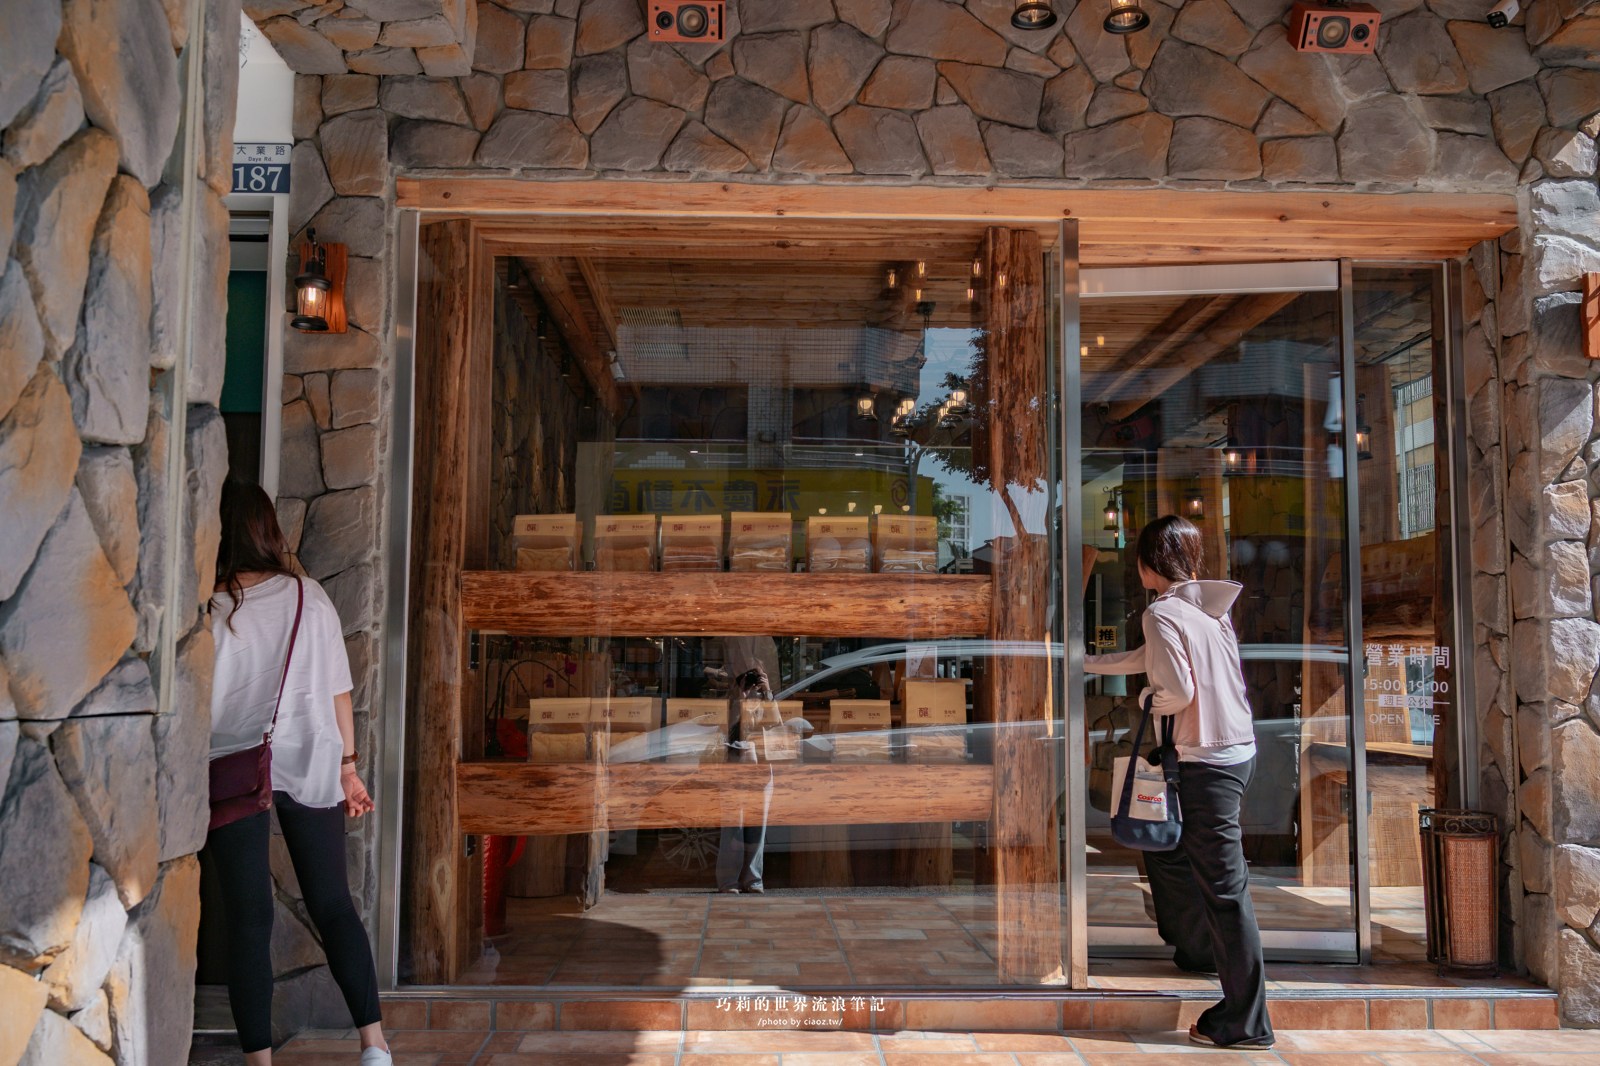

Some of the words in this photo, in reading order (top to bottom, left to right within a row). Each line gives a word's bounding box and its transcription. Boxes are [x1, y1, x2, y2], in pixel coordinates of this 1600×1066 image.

[236, 145, 285, 155] 大業路
[234, 165, 283, 191] 187
[1098, 629, 1115, 641] 推
[1365, 643, 1450, 669] 營業時間
[1383, 694, 1429, 707] 週日公休
[1369, 713, 1404, 725] OPEN
[1137, 793, 1163, 803] COSTCO
